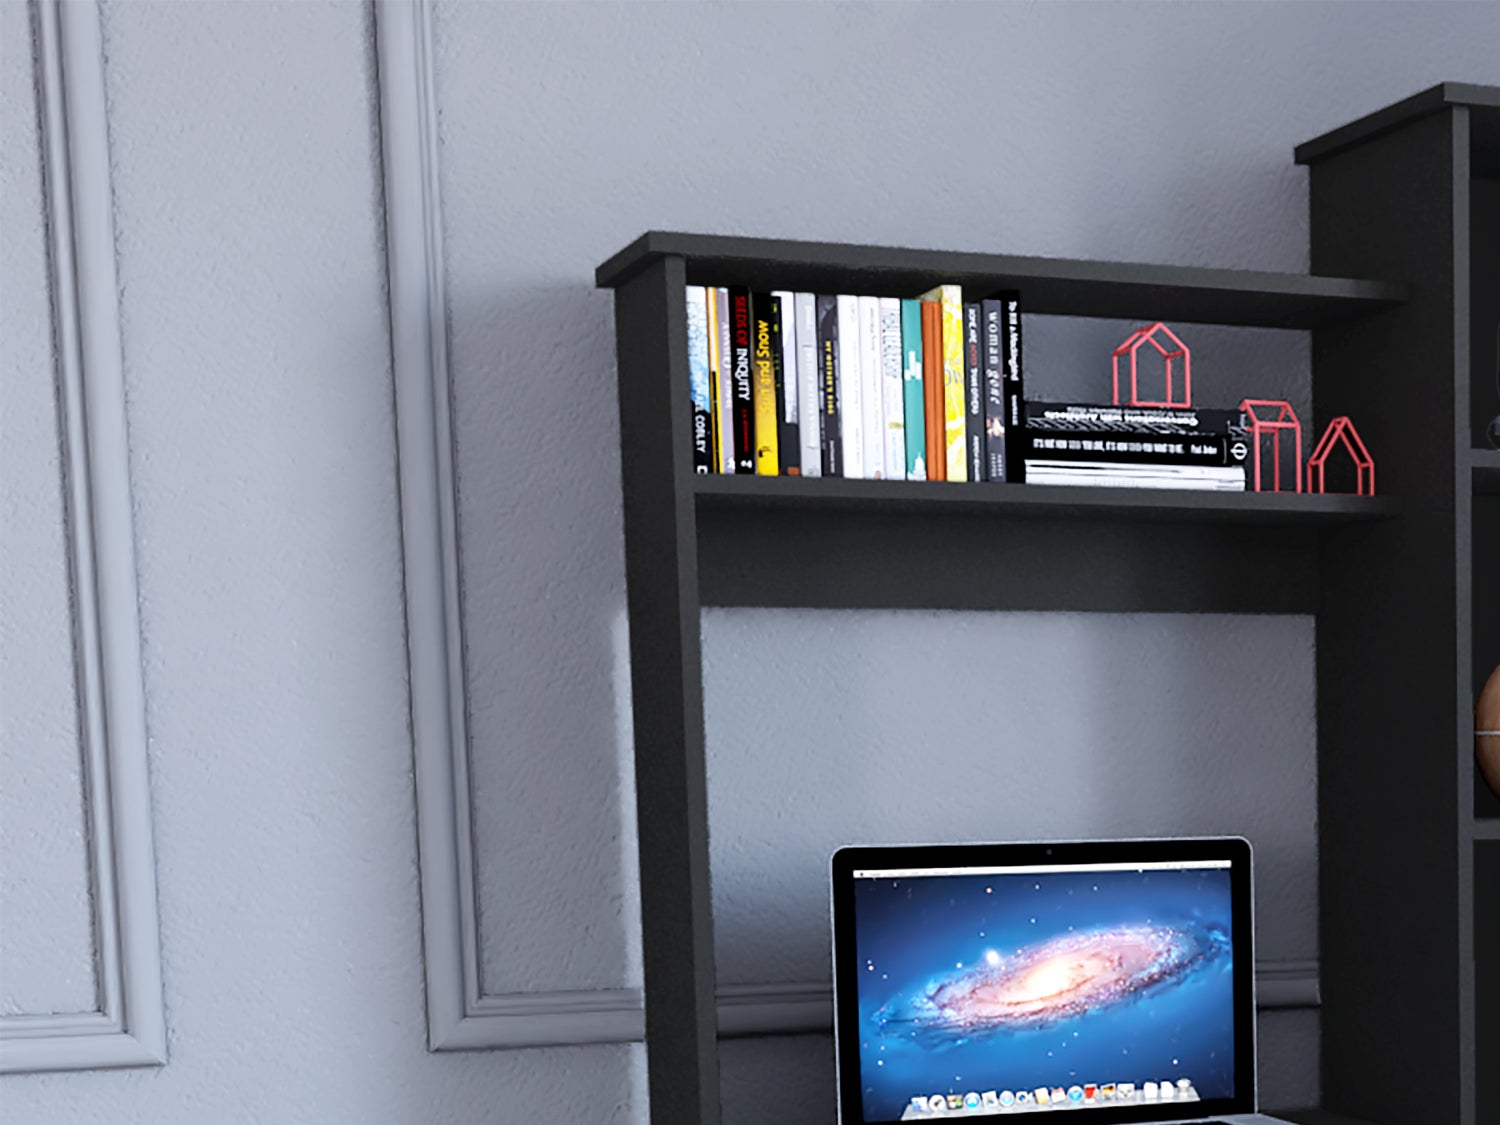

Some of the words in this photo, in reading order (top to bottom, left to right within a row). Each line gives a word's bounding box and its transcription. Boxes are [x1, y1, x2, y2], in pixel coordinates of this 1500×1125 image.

[737, 329, 748, 346] OF
[756, 319, 771, 359] Snow
[987, 311, 999, 365] woman
[734, 347, 751, 401] INIQUITY
[756, 360, 771, 386] and
[985, 368, 1002, 405] gone
[757, 388, 772, 414] Sun
